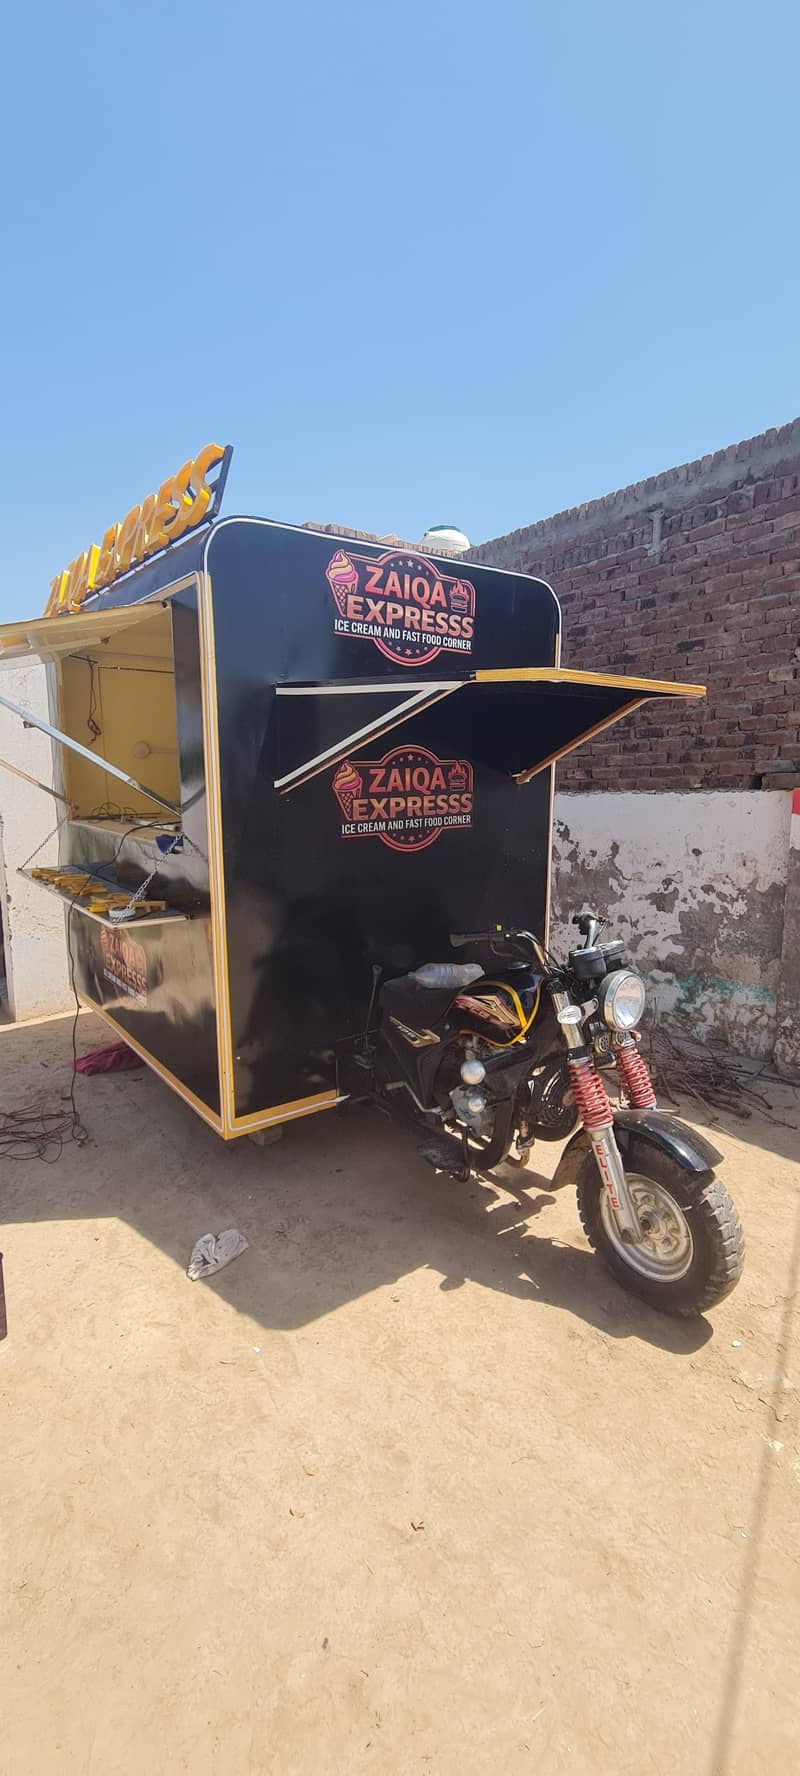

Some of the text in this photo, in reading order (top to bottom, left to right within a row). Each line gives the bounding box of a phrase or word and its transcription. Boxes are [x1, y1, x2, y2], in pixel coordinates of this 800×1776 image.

[364, 565, 447, 609] ZAIQA
[346, 594, 474, 638] EXPRESSS
[334, 619, 471, 650] ICE CREAM AND FAST FOOD CORNER
[368, 766, 447, 796] ZAIQA
[352, 793, 473, 821] EXPRESSS
[341, 814, 471, 835] ICE CREAM AND FAST FOOD CORNER
[595, 1144, 619, 1208] ELITE
